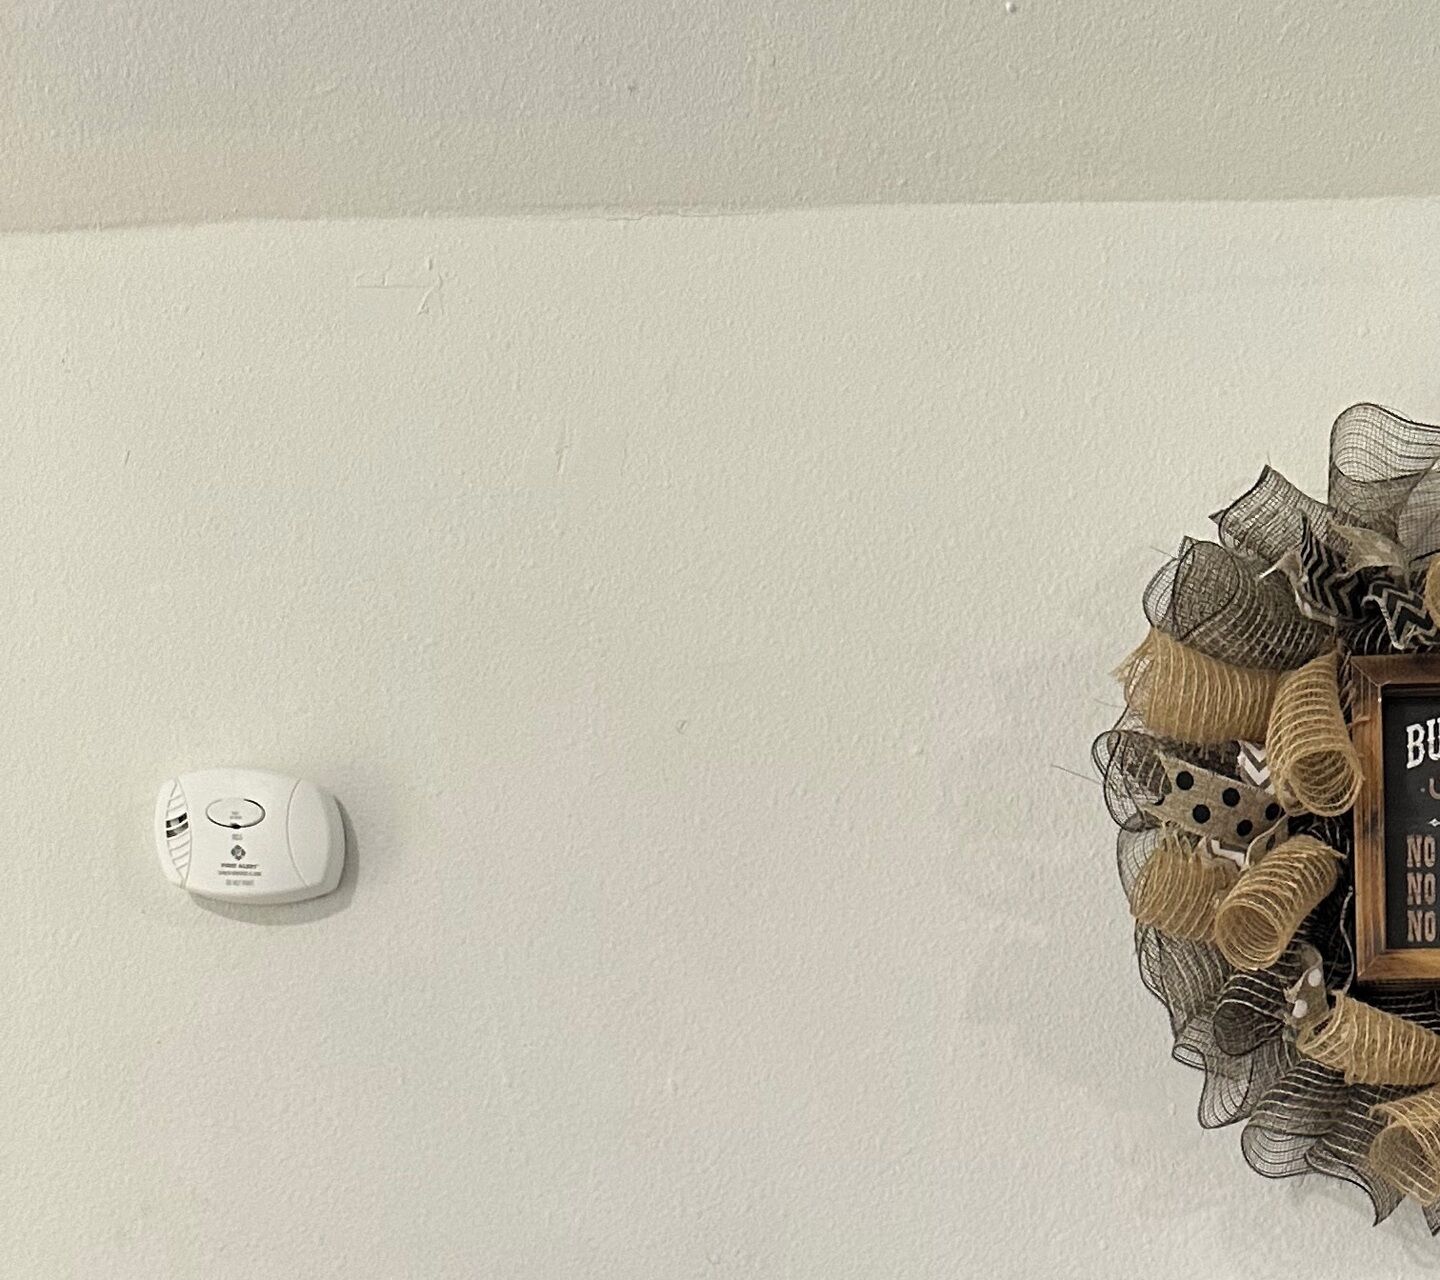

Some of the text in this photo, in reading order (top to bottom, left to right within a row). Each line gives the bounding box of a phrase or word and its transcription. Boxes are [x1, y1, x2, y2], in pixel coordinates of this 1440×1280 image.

[1406, 834, 1436, 868] NO
[1406, 873, 1436, 906] NO
[1407, 910, 1437, 942] NO
